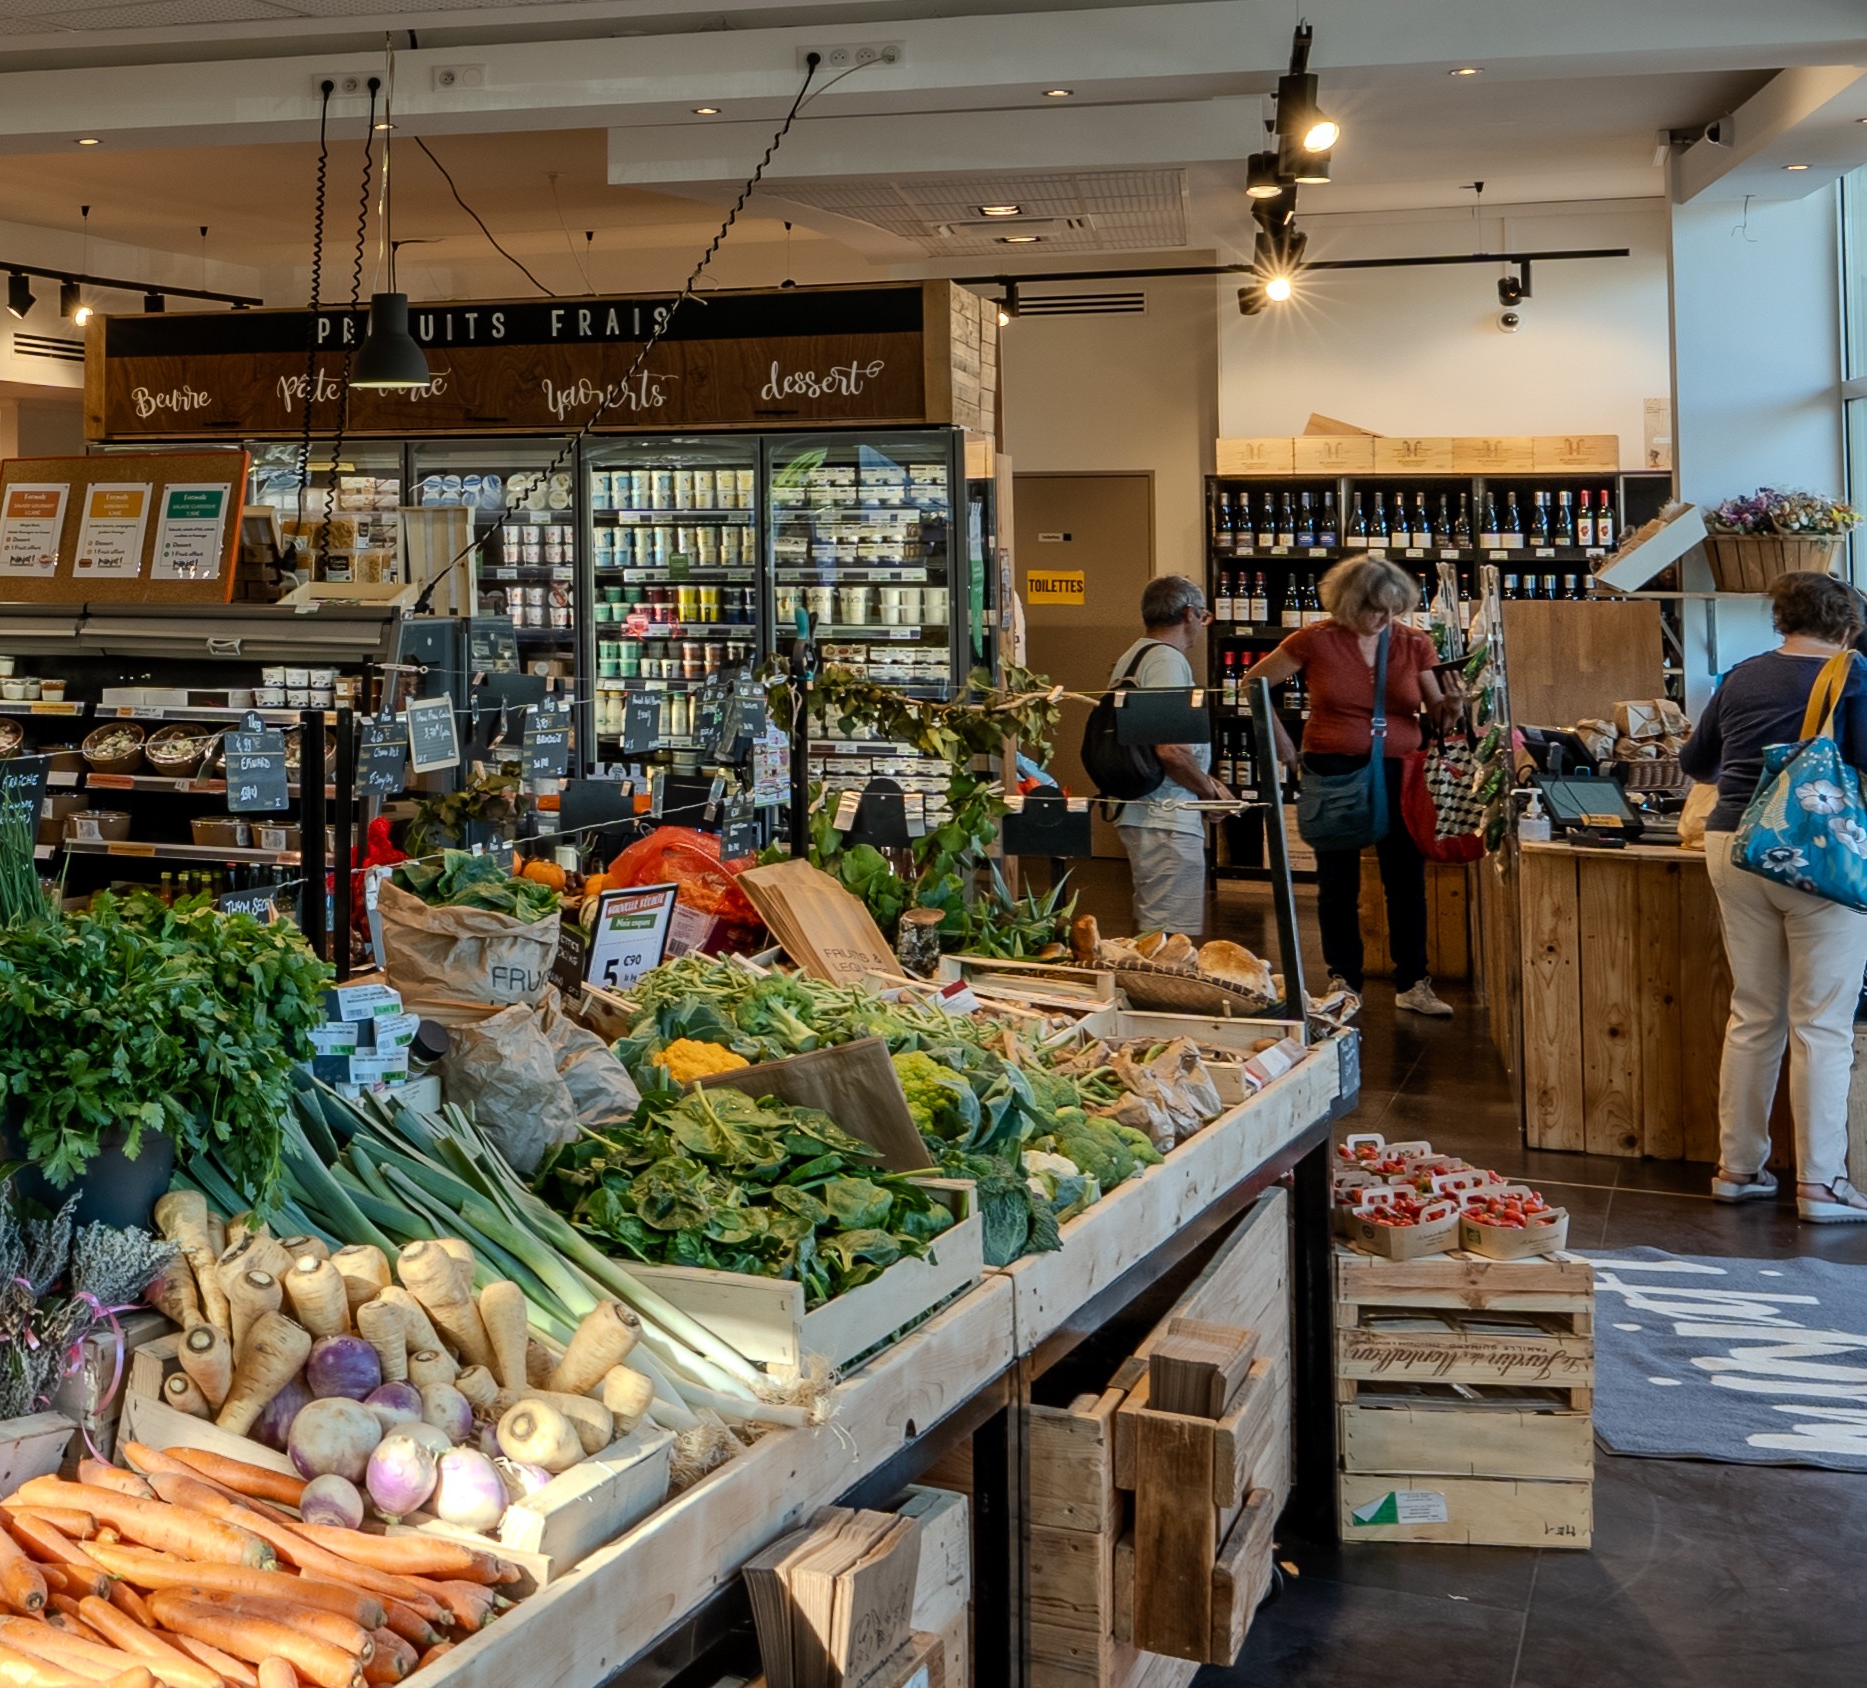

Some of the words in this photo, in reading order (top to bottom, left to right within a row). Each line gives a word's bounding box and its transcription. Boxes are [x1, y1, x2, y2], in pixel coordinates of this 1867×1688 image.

[318, 312, 505, 344] PRUITS
[551, 307, 668, 337] FRAIS
[761, 360, 884, 401] dessert
[131, 386, 212, 419] Beurre
[1028, 578, 1084, 593] TOILETTES
[247, 714, 262, 732] 1kg
[225, 900, 250, 914] THYM
[823, 948, 870, 963] FRUITS
[604, 959, 620, 987] 5
[1488, 1350, 1566, 1381] Jardin
[1563, 1356, 1585, 1374] Le
